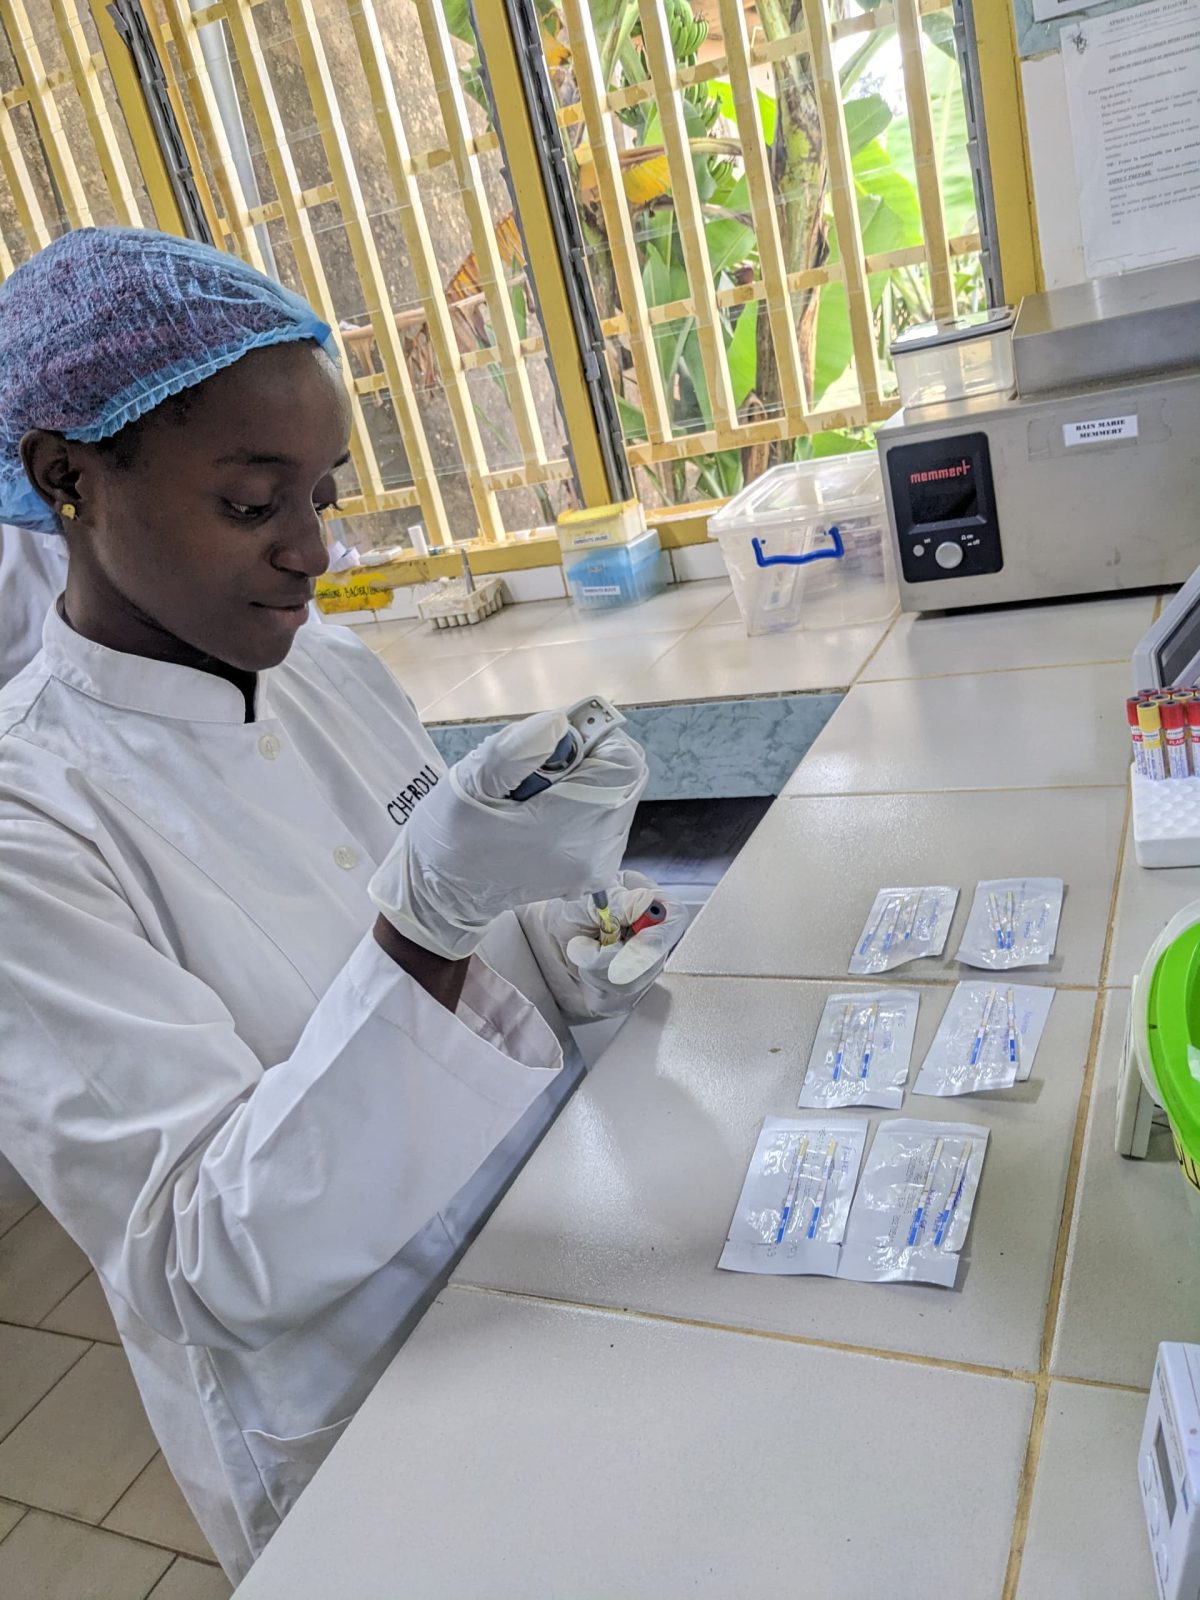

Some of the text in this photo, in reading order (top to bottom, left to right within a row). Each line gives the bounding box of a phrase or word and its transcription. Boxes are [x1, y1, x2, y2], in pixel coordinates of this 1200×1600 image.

[1076, 419, 1126, 431] BAIN MARIE
[1080, 428, 1123, 438] MEMMERT
[910, 460, 970, 483] memmert
